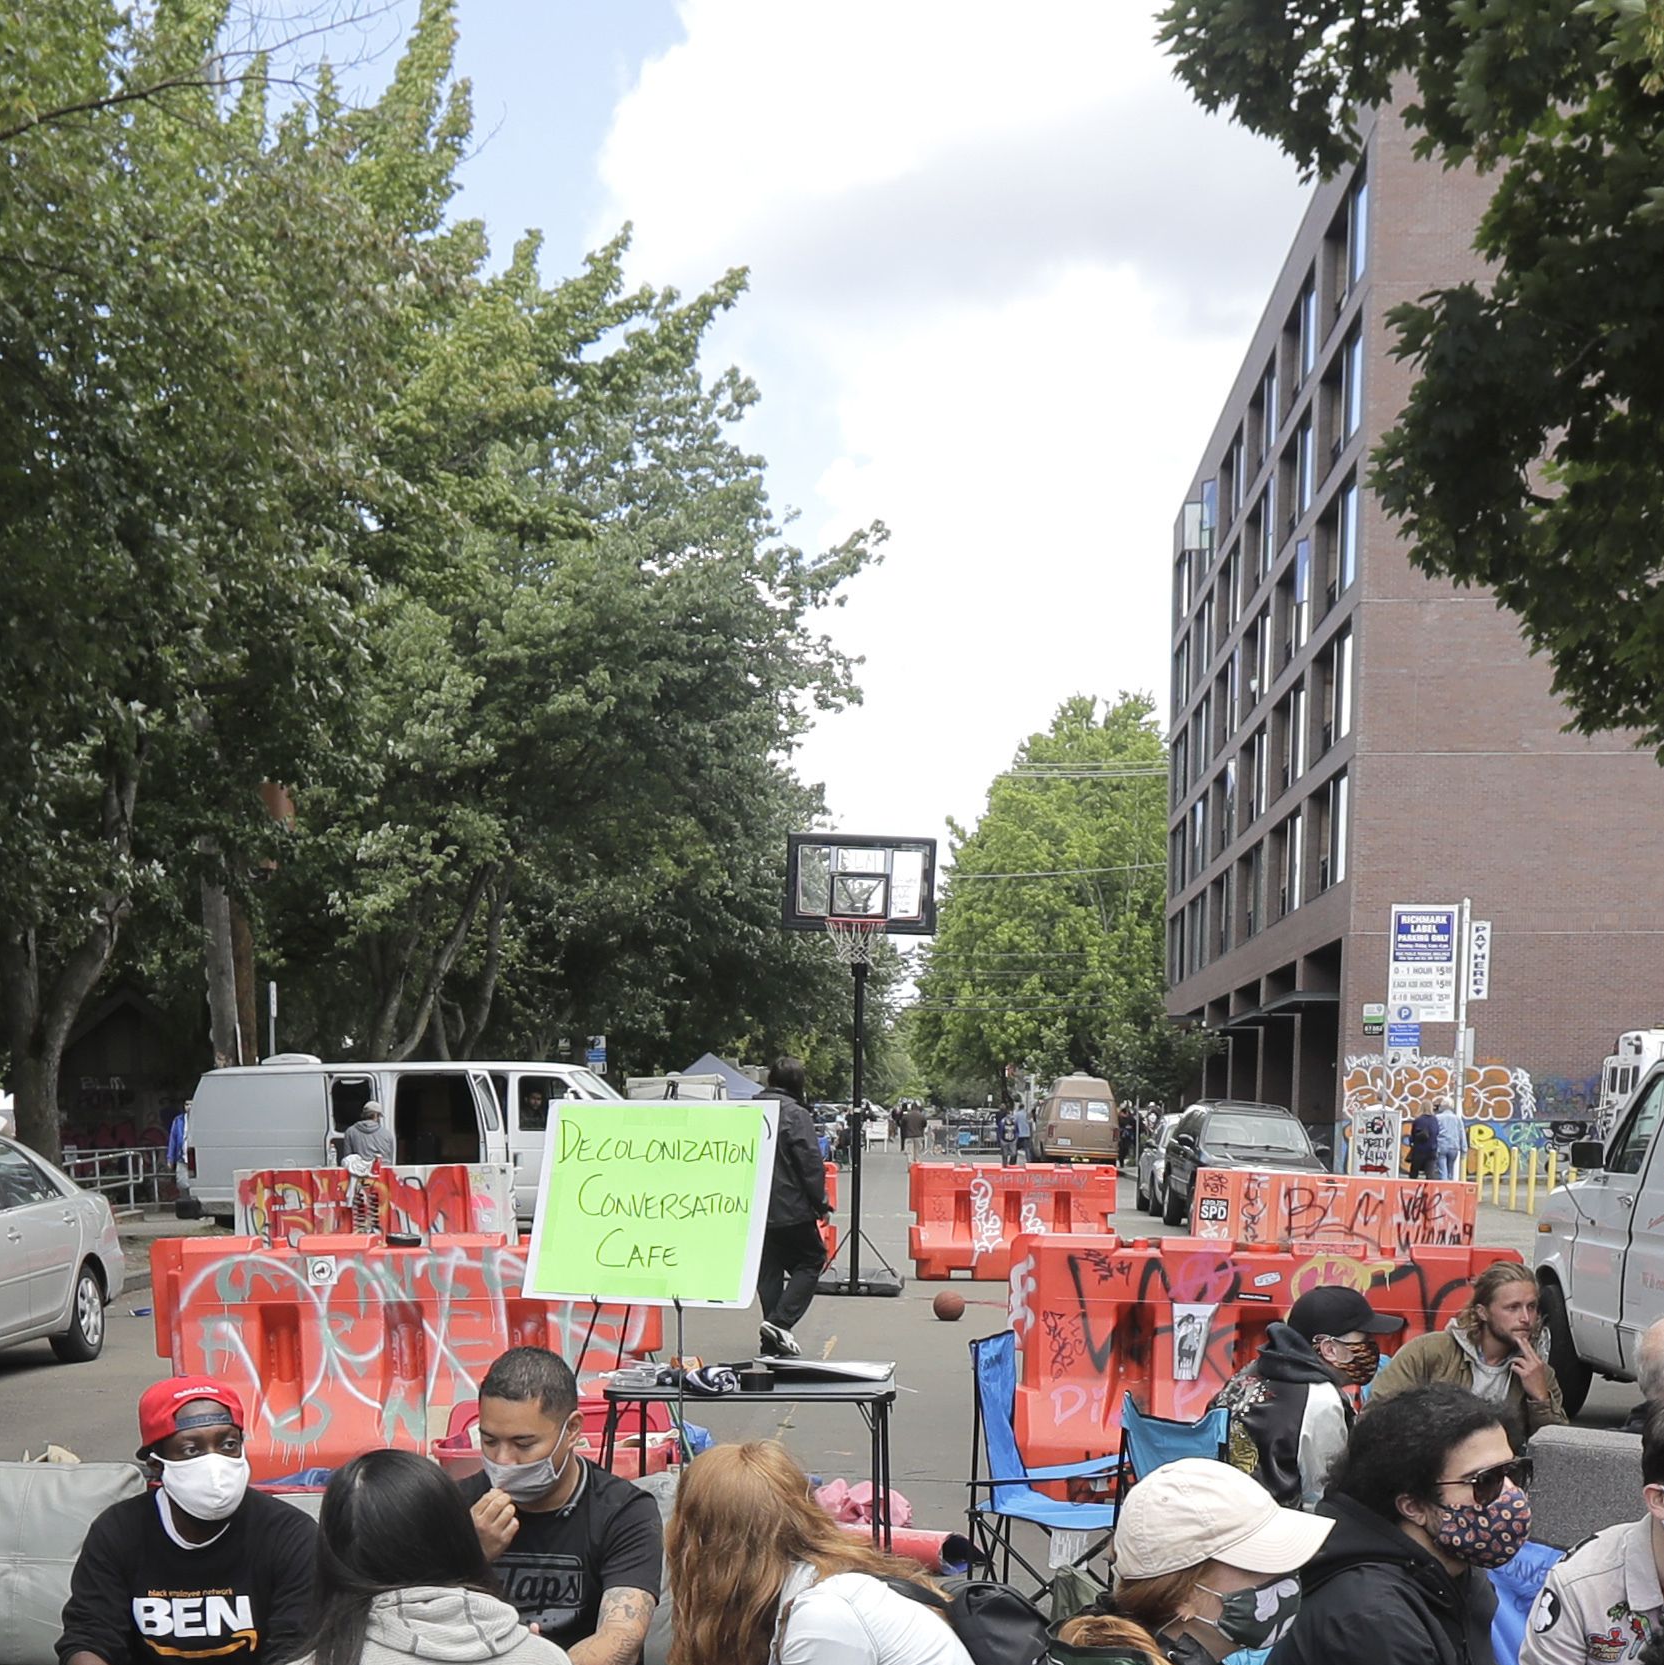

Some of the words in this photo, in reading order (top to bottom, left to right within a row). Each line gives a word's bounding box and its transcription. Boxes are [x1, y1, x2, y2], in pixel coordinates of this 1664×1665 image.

[1400, 915, 1447, 924] RICHMARK
[1410, 925, 1438, 933] LABEL
[1474, 926, 1487, 950] PAY
[1473, 953, 1485, 986] HERE
[558, 1120, 755, 1164] DECOLONIZATION
[578, 1173, 749, 1220] CONVERSATION
[1200, 1205, 1228, 1220] SPD
[595, 1228, 679, 1268] CAFE
[132, 1595, 254, 1637] BEN
